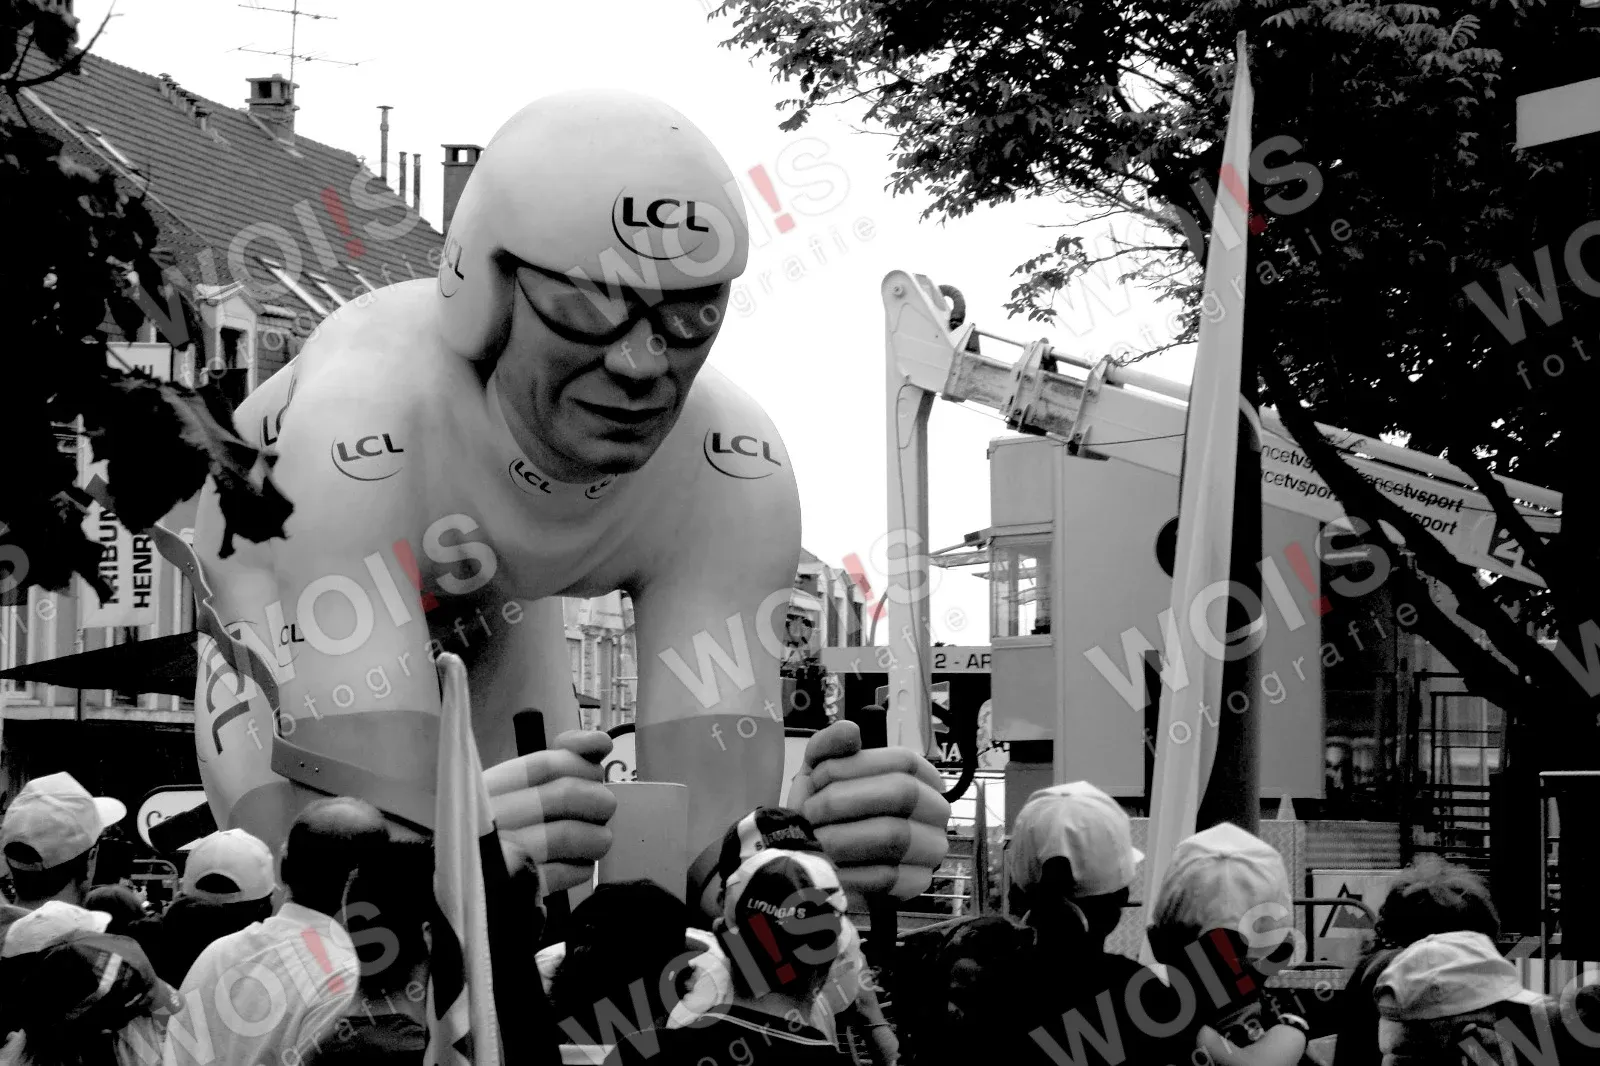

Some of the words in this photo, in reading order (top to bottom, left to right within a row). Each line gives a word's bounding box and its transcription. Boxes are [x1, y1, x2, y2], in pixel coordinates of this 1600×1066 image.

[622, 197, 709, 233] LCL
[337, 433, 404, 462] LCL
[711, 432, 782, 467] LCL
[514, 460, 552, 494] LCL
